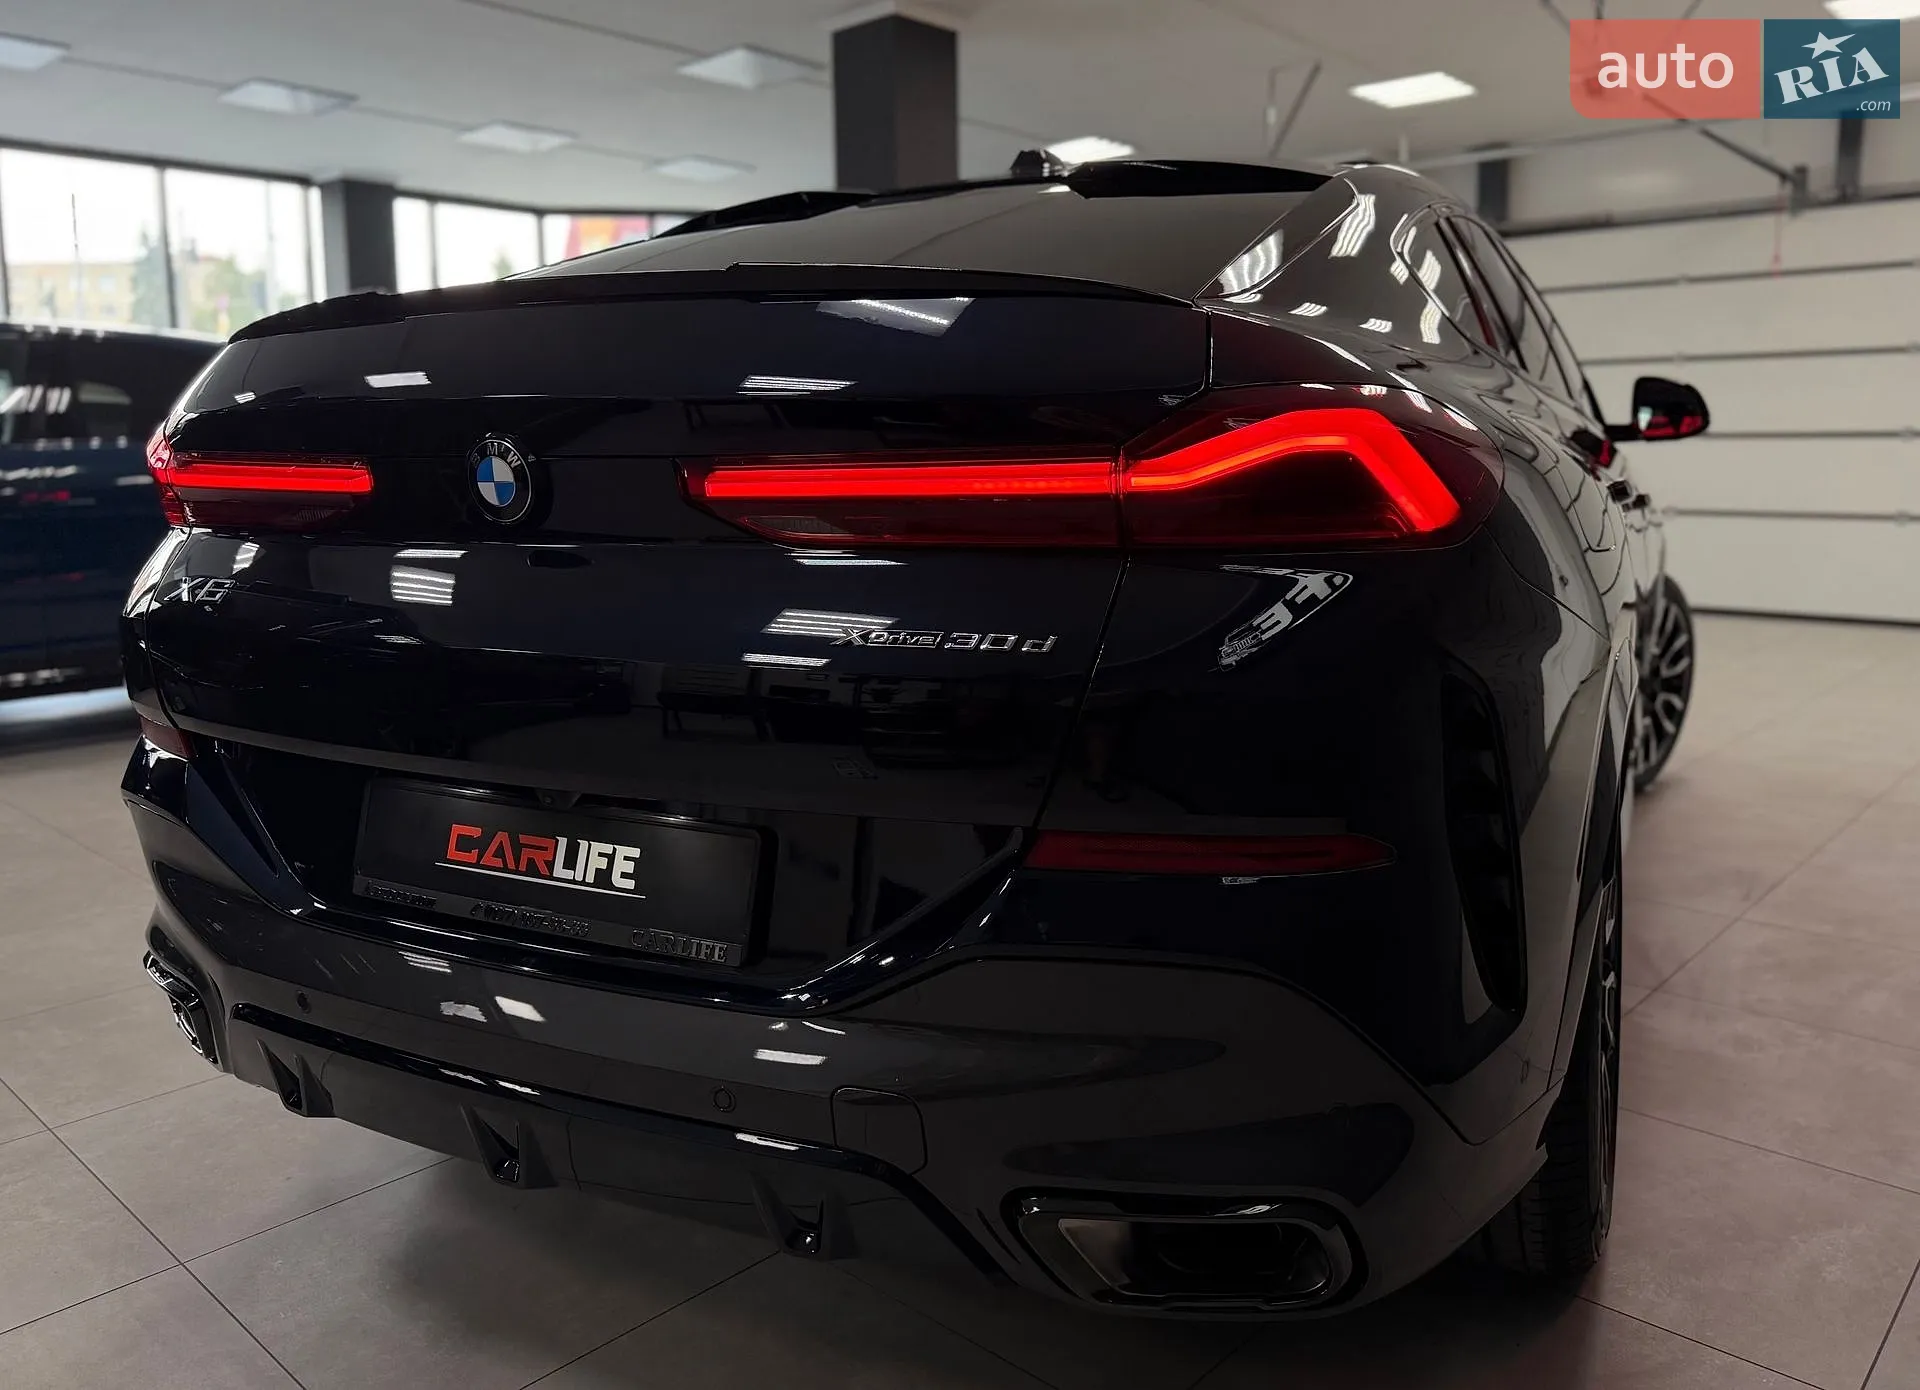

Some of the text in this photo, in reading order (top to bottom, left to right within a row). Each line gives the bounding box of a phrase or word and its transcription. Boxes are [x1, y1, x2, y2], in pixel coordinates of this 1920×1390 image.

[164, 577, 235, 604] X6
[446, 823, 641, 890] CARLIFE
[630, 927, 729, 963] CARLIFE
